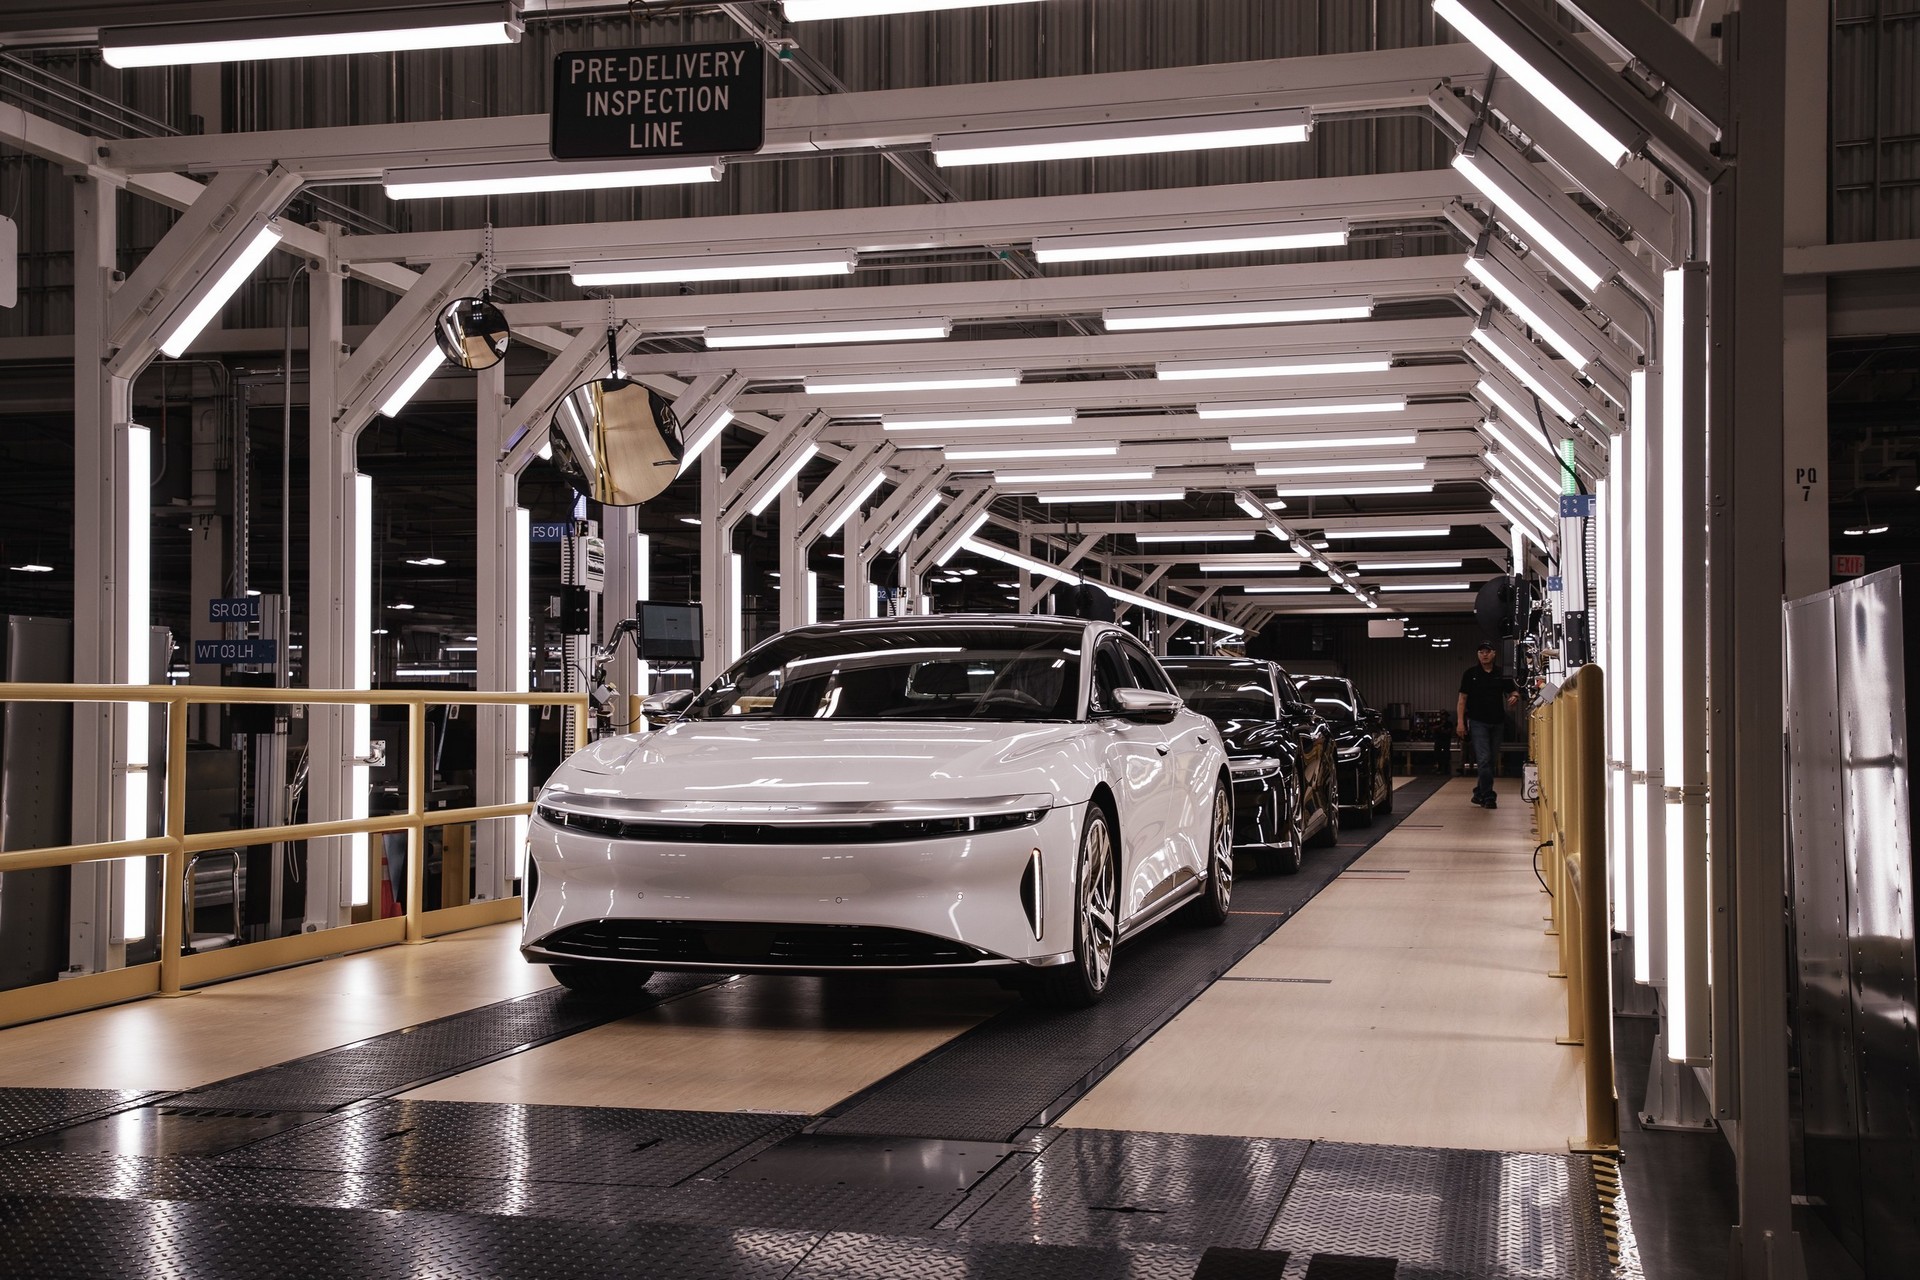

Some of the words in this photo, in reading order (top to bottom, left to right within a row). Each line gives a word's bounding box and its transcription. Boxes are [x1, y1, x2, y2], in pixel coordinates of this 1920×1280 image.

[571, 50, 745, 84] PRE-DELIVERY
[586, 85, 729, 117] INSPECTION
[630, 121, 683, 149] LINE
[1796, 467, 1817, 484] PQ
[1802, 486, 1811, 502] 7
[203, 527, 209, 540] 7
[532, 526, 546, 538] FS
[547, 526, 559, 538] 01
[1836, 556, 1860, 574] EXIT
[211, 603, 230, 617] SR
[231, 603, 248, 617] 03
[197, 644, 219, 658] WT
[220, 644, 236, 658] 03
[237, 644, 254, 658] LH
